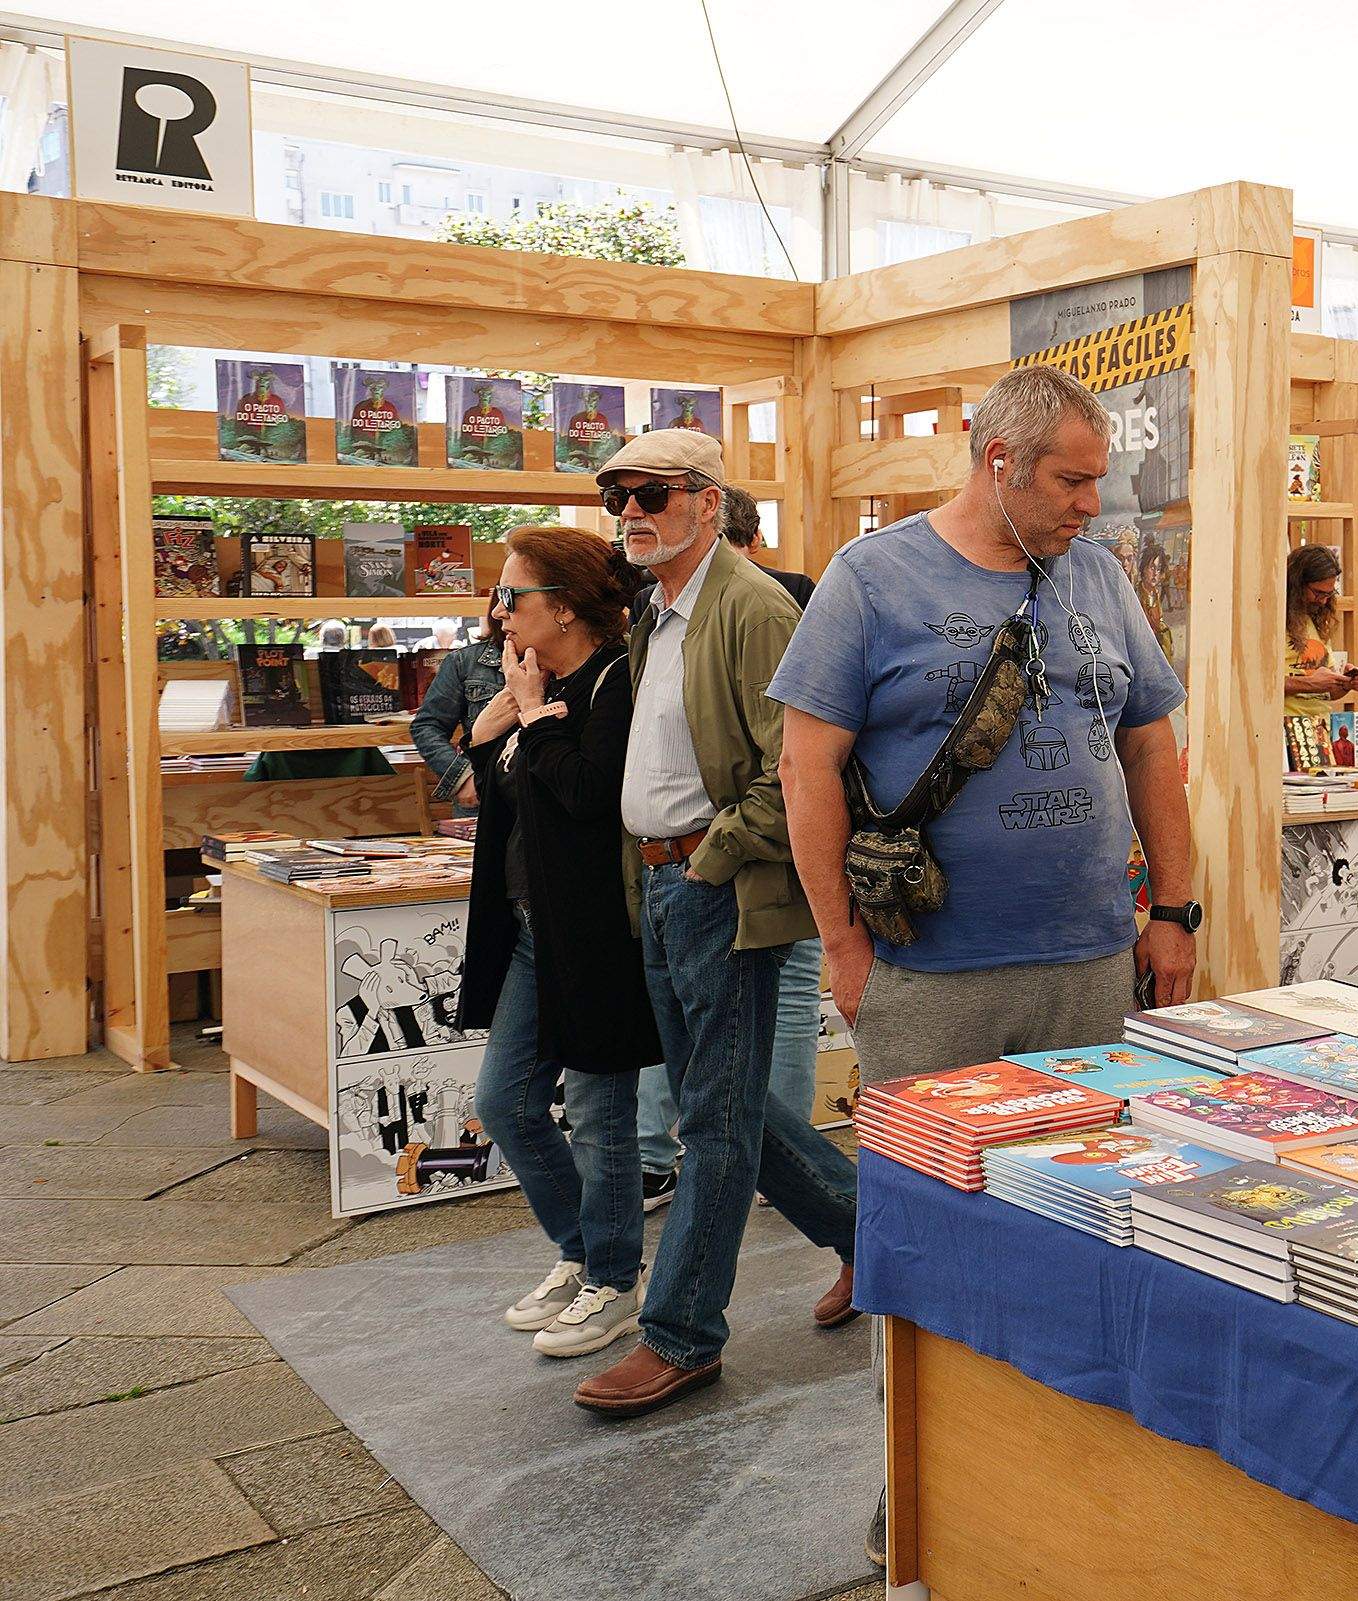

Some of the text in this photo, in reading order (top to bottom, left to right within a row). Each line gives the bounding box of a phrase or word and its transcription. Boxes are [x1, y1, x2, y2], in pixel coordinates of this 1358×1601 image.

[171, 180, 214, 192] EDITORA
[1057, 296, 1137, 319] MIGUELANXO PRADO
[1096, 324, 1177, 376] FÁCILES
[244, 403, 280, 414] O PACTO
[236, 412, 249, 421] DO
[359, 410, 394, 421] O PACTO
[352, 419, 364, 428] DO
[476, 417, 500, 427] PACTO
[999, 787, 1093, 812] STAR
[999, 802, 1093, 830] WARS
